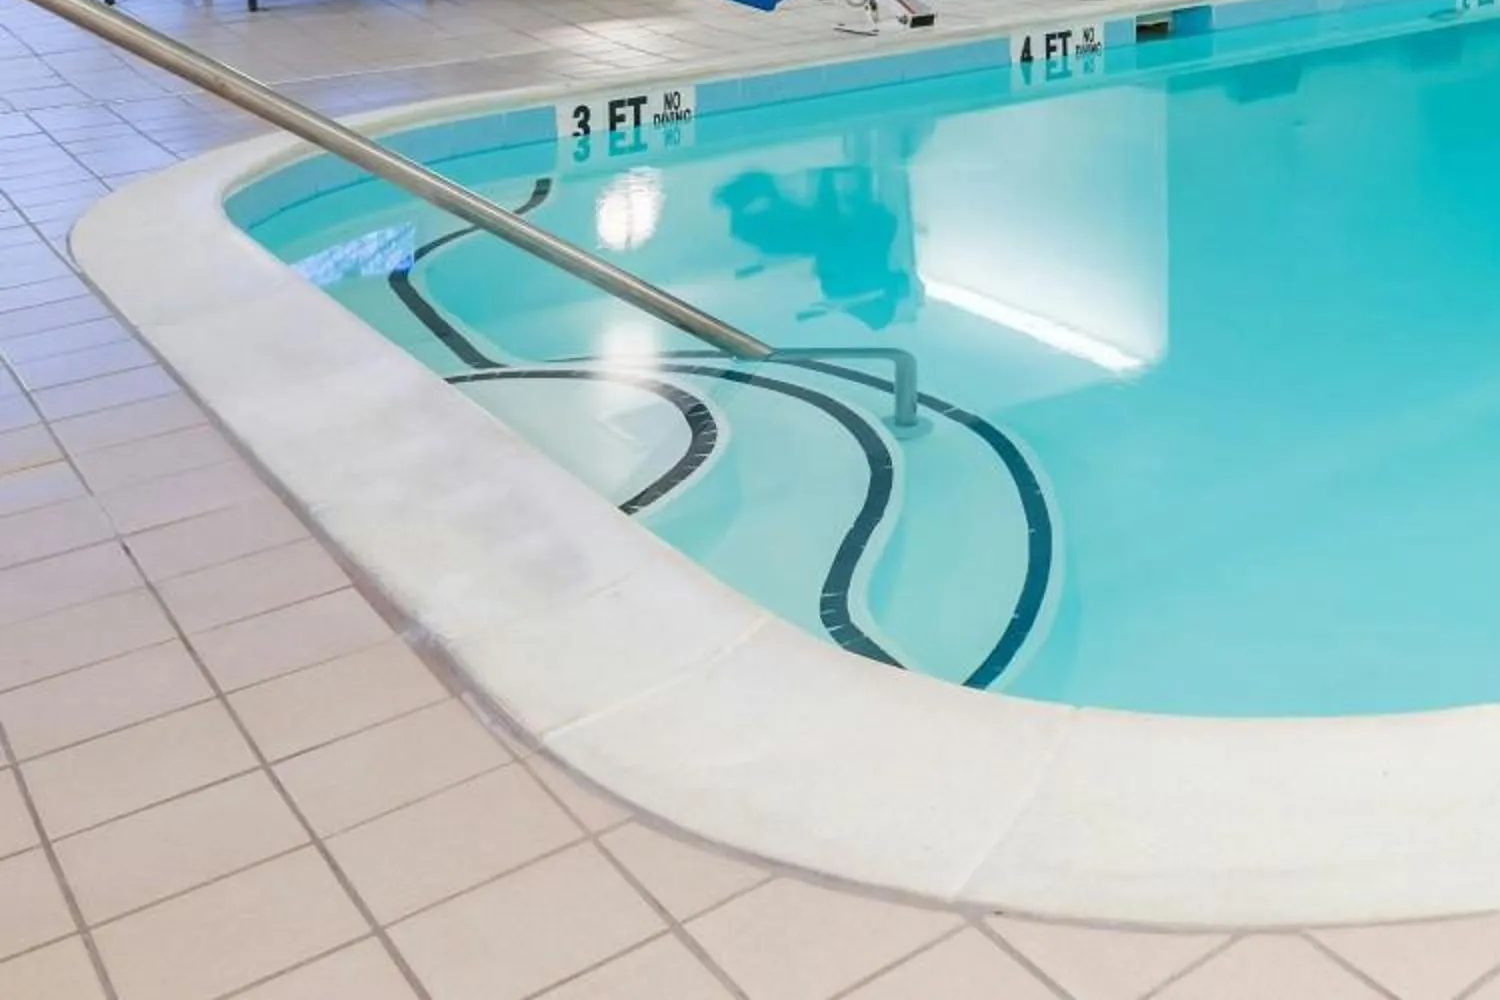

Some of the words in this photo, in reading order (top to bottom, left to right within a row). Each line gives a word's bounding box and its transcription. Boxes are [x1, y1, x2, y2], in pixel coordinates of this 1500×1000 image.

[1020, 36, 1033, 63] 4
[1045, 30, 1072, 60] FT
[572, 105, 590, 137] 3
[608, 96, 647, 131] FT
[664, 91, 680, 110] NO
